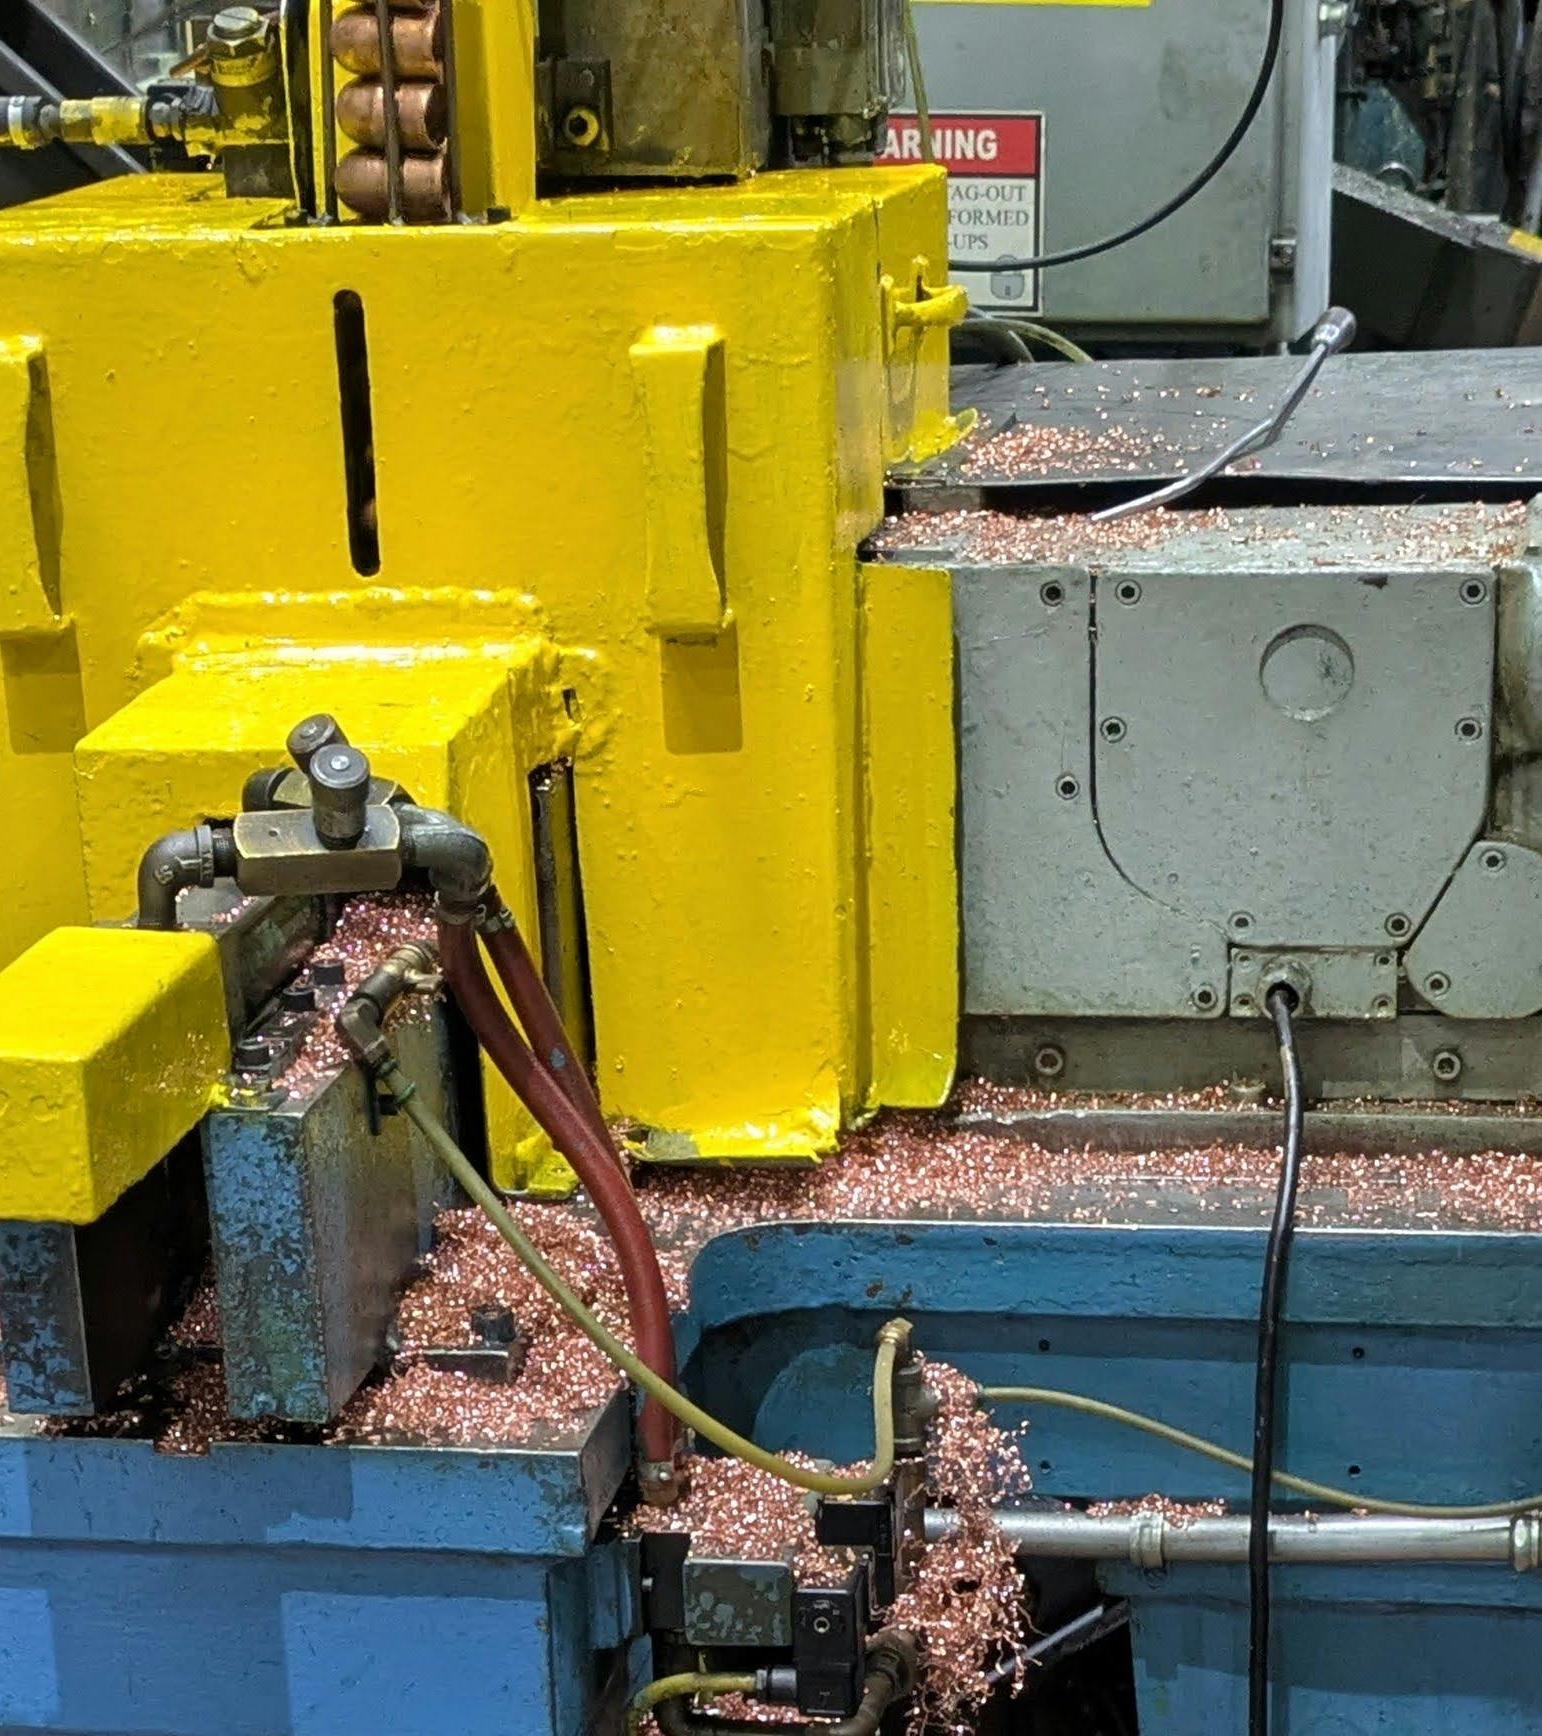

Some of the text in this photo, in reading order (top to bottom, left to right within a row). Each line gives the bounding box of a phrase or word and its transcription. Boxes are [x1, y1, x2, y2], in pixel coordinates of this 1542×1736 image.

[879, 128, 998, 161] ARNING
[948, 209, 1030, 227] FORMED
[948, 233, 989, 250] -UPS
